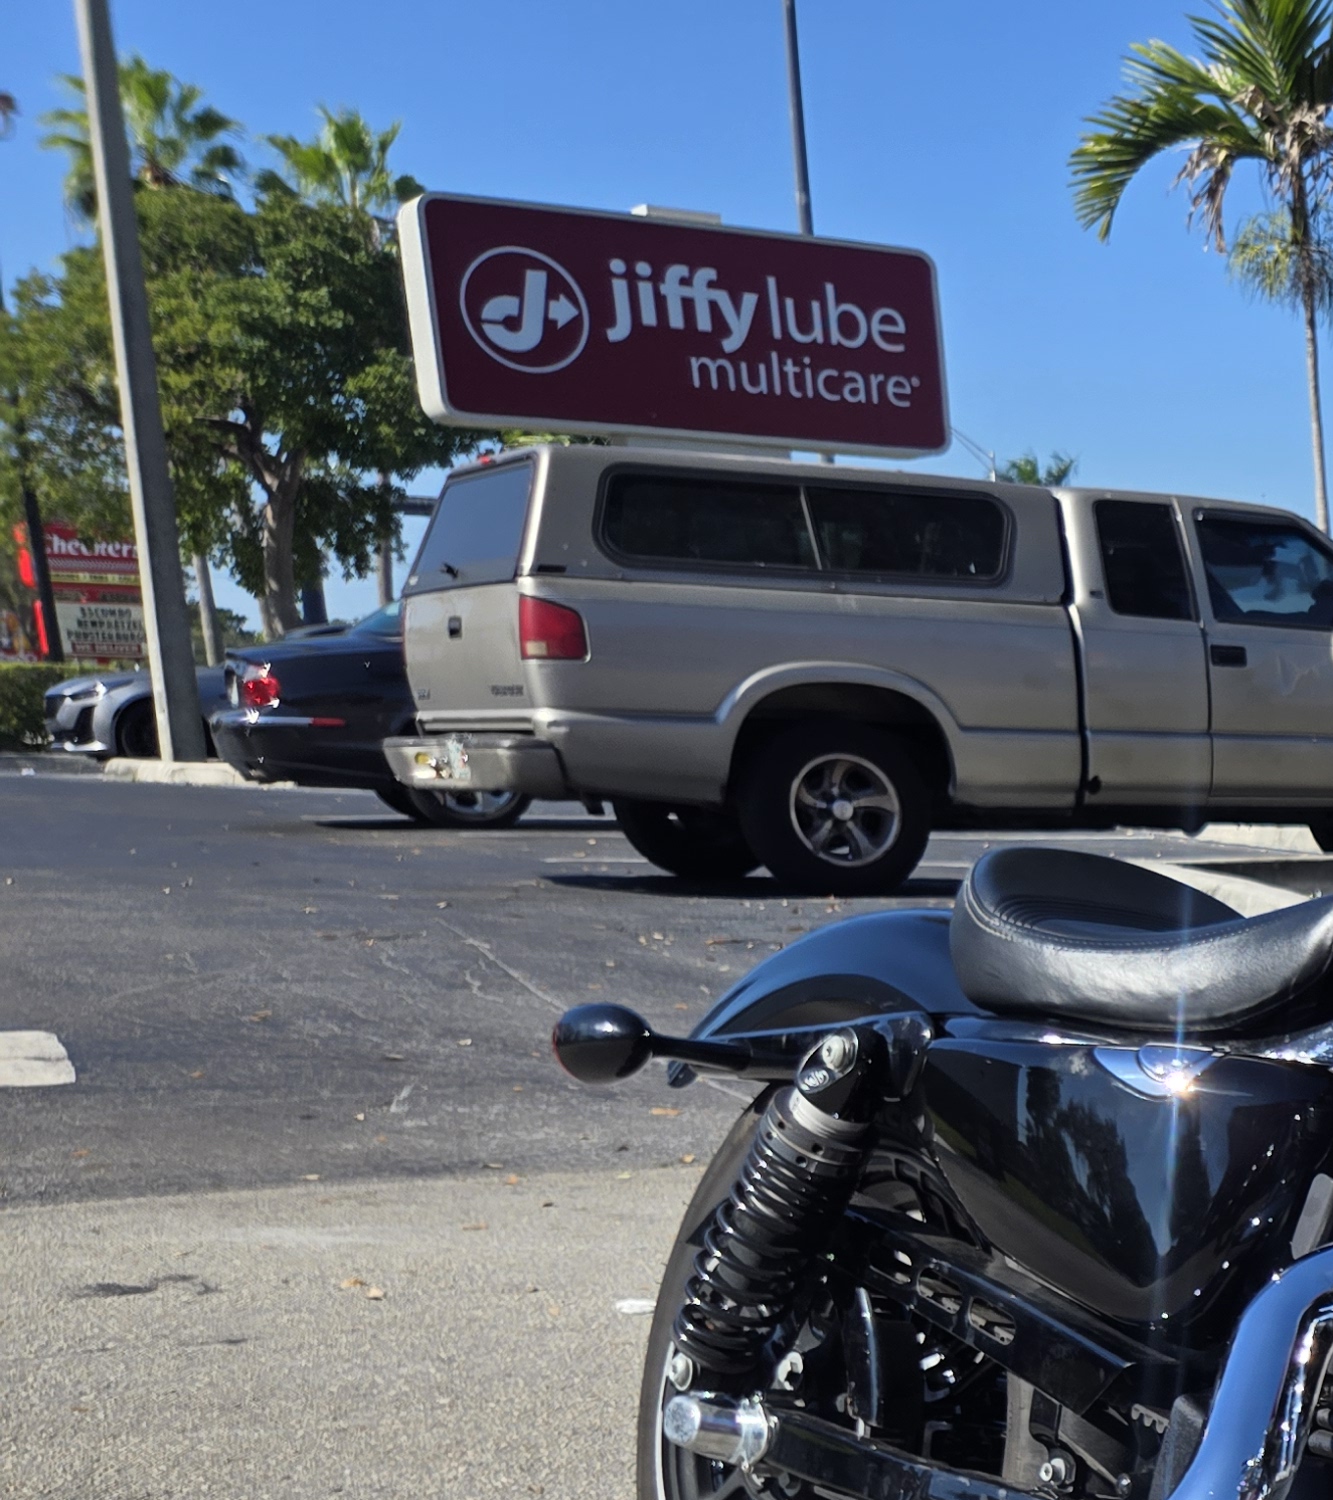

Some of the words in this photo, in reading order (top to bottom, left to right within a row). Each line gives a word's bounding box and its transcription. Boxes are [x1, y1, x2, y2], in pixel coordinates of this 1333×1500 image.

[605, 258, 758, 354] jiffy
[766, 275, 907, 352] lube
[689, 351, 913, 408] multicare
